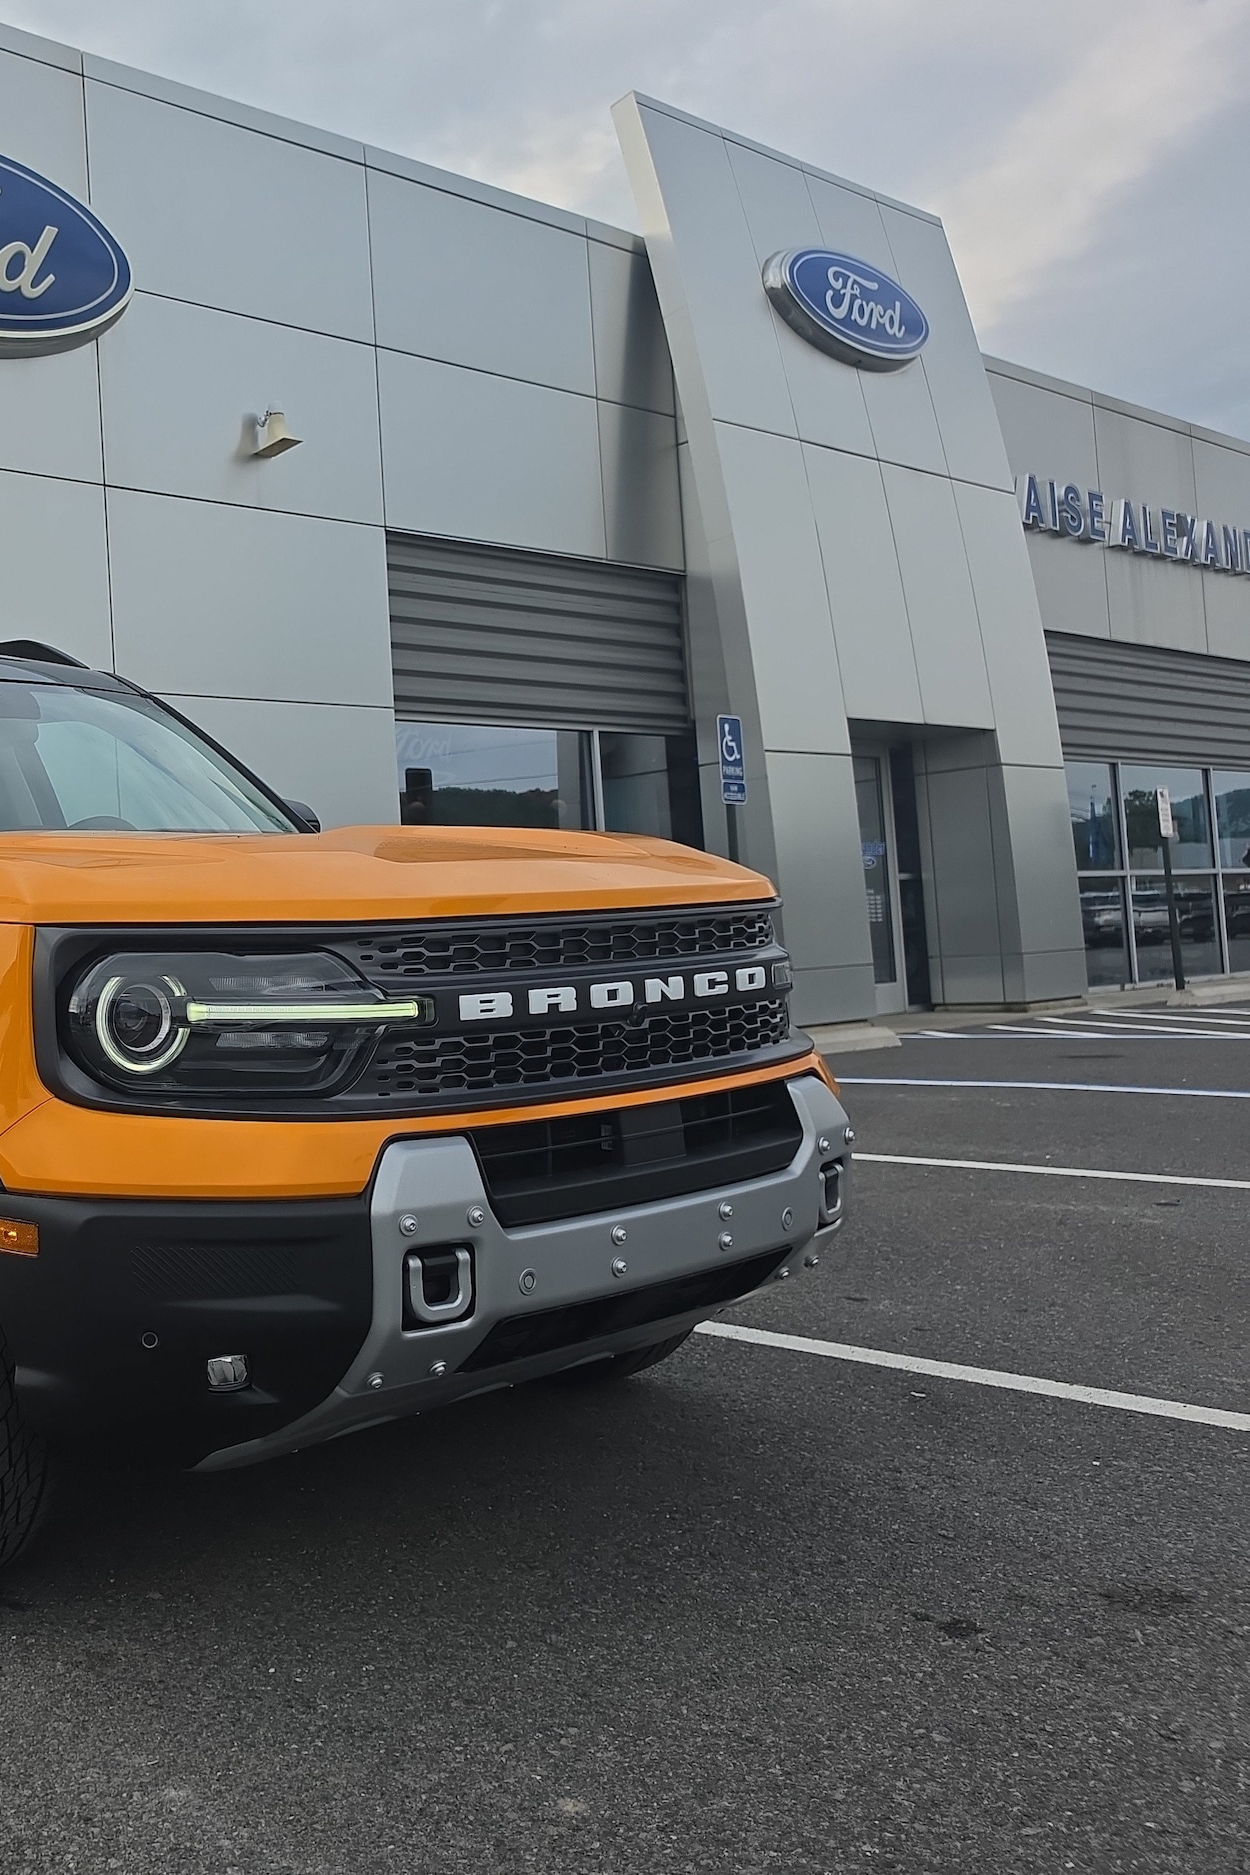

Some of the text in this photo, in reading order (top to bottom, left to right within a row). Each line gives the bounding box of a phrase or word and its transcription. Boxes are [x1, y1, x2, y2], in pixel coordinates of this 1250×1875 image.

[825, 266, 906, 338] Ford
[1022, 473, 1108, 542] AISE
[723, 766, 743, 777] PARKING
[458, 966, 766, 1021] BRONCO
